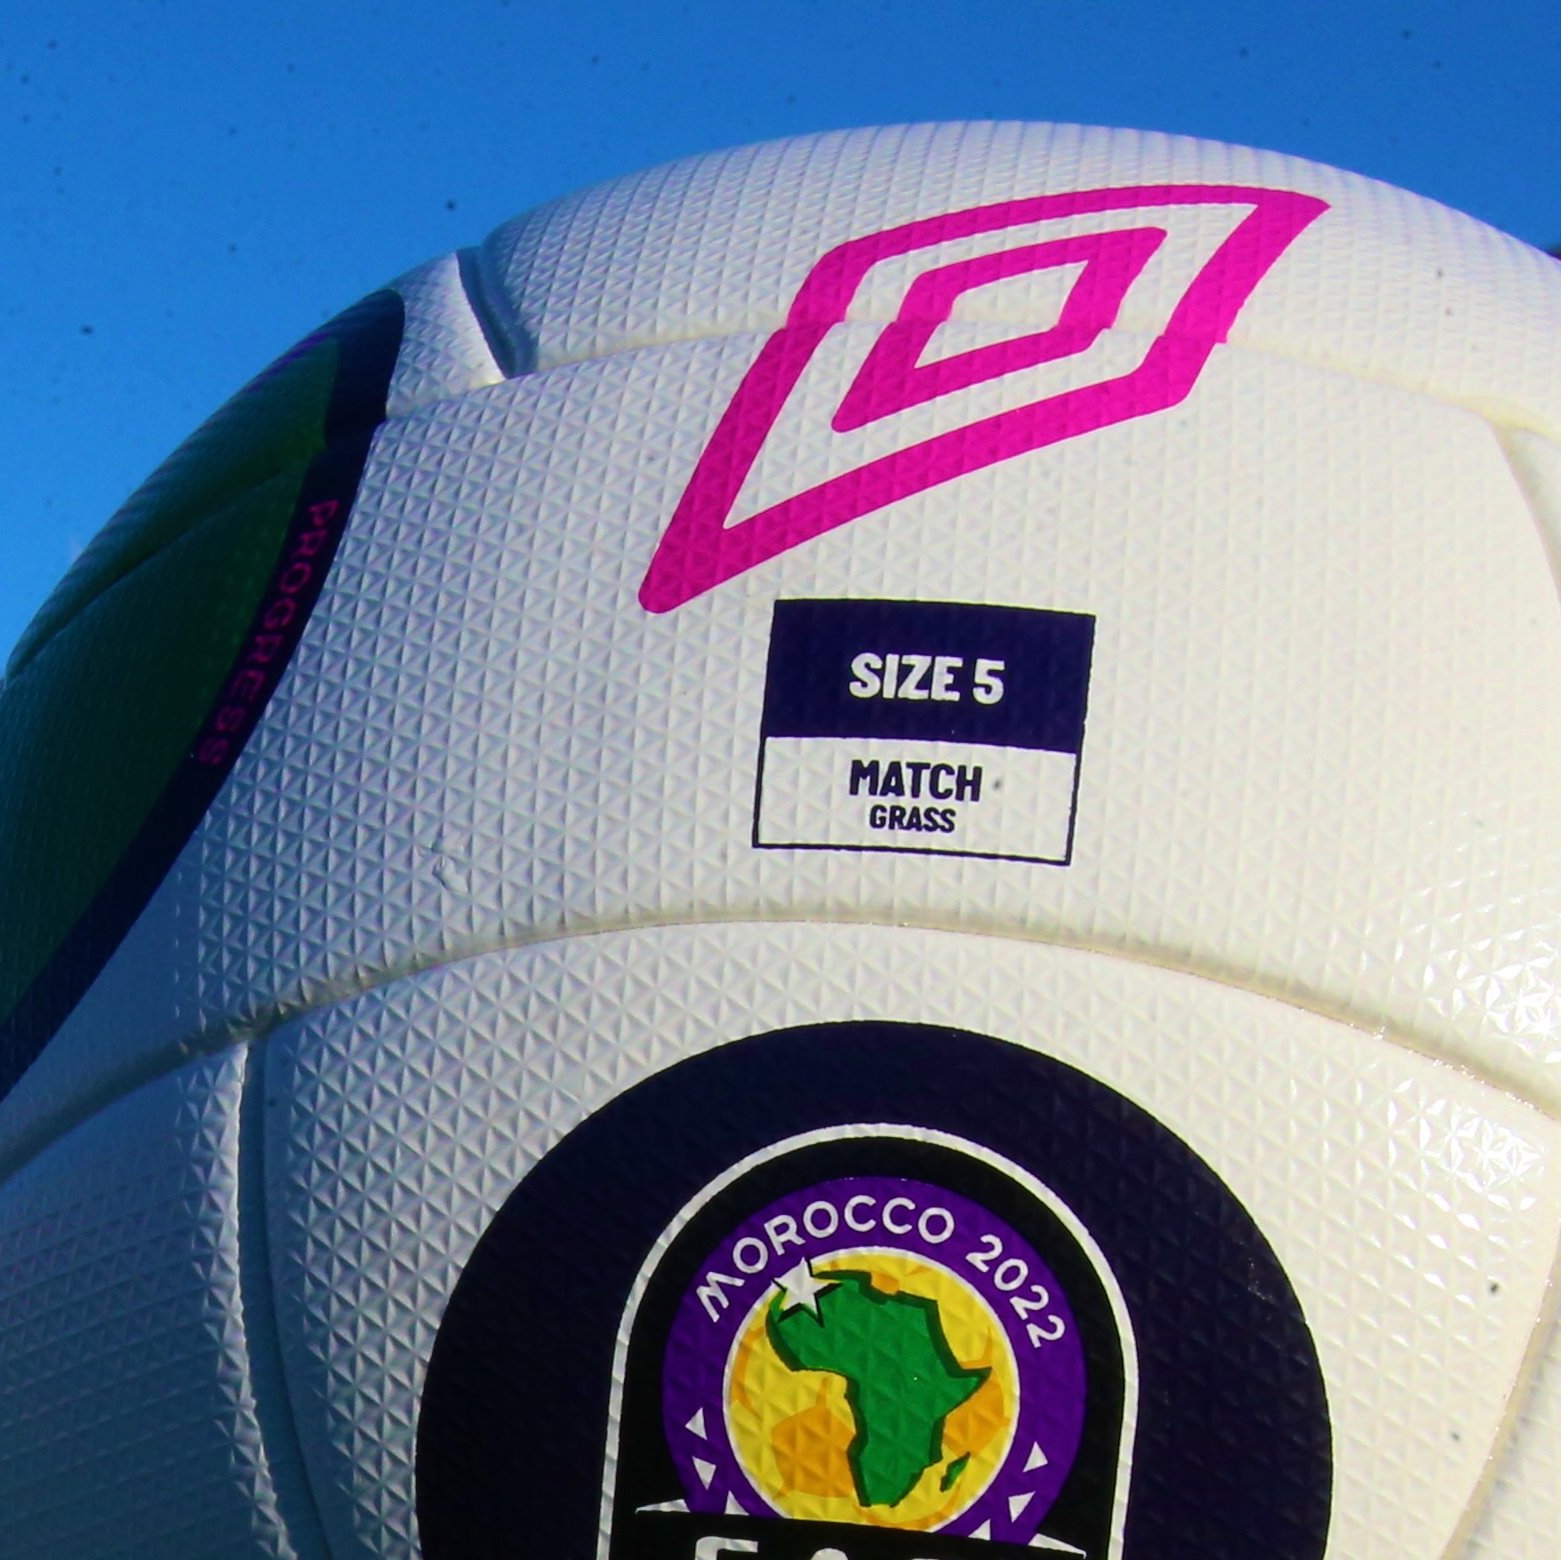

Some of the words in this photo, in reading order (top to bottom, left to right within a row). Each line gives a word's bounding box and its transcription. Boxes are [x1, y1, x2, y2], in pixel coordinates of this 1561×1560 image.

[198, 500, 339, 766] PROGRESS
[848, 652, 964, 701] SIZE
[972, 658, 1006, 705] 5
[848, 759, 983, 802] MATCH
[869, 804, 957, 833] GRASS
[696, 1194, 955, 1323] MOROCCO
[965, 1234, 1065, 1348] 2022
